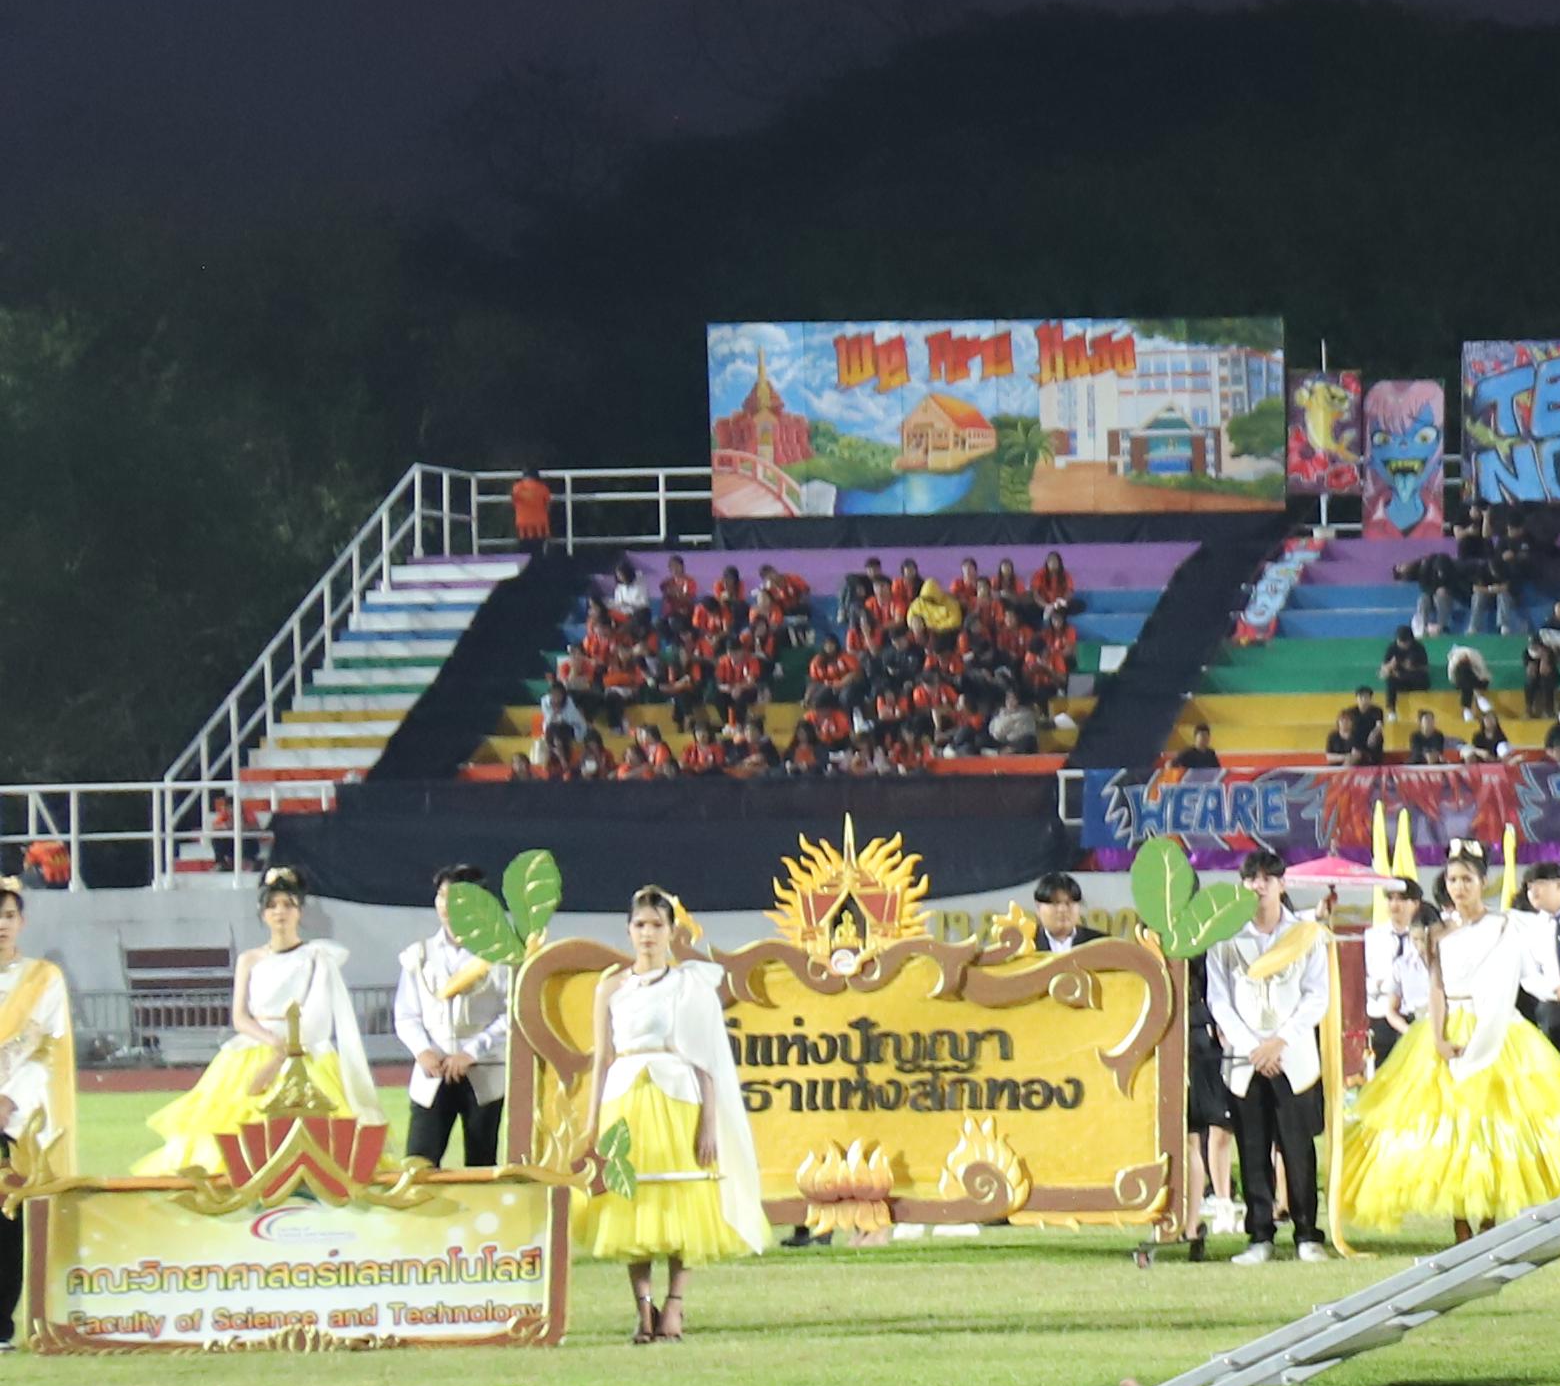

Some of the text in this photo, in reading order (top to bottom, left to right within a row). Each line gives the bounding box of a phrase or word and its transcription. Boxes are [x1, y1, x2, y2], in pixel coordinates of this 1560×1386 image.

[67, 1246, 543, 1295] คณะวิทยาศาสตร์และเทคโนโลยี
[176, 1306, 202, 1332] of
[212, 1305, 318, 1330] Science
[328, 1303, 377, 1328] and
